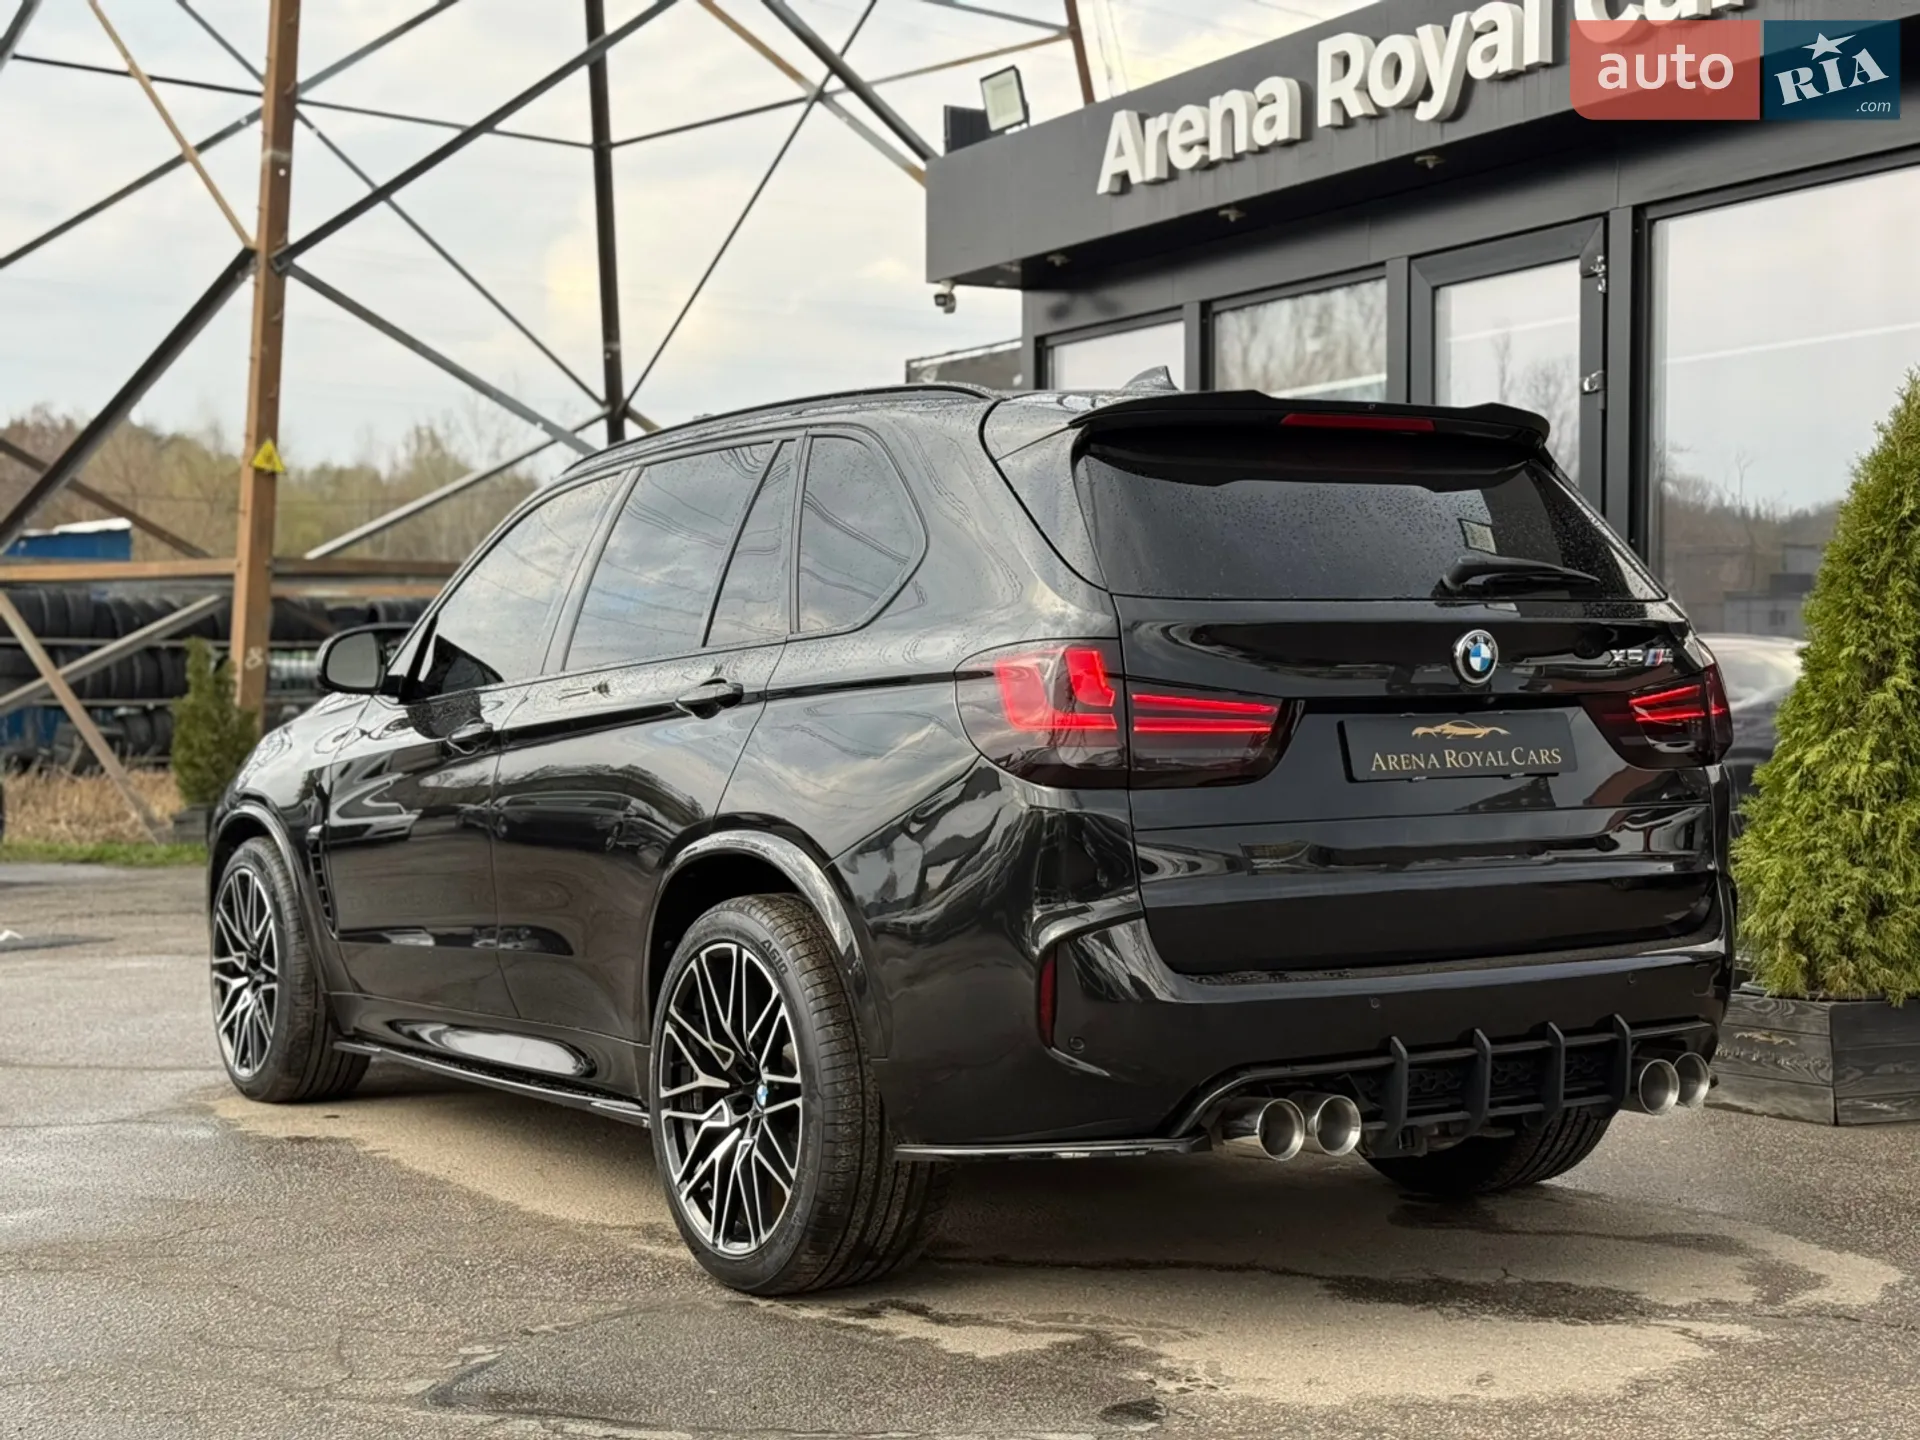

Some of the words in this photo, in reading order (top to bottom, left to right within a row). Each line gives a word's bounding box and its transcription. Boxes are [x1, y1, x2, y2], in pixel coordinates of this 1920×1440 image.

[1097, 76, 1302, 194] Arena
[1317, 0, 1553, 128] Royal
[1371, 752, 1441, 771] ARENA
[1444, 749, 1509, 768] ROYAL
[1511, 747, 1562, 765] CARS
